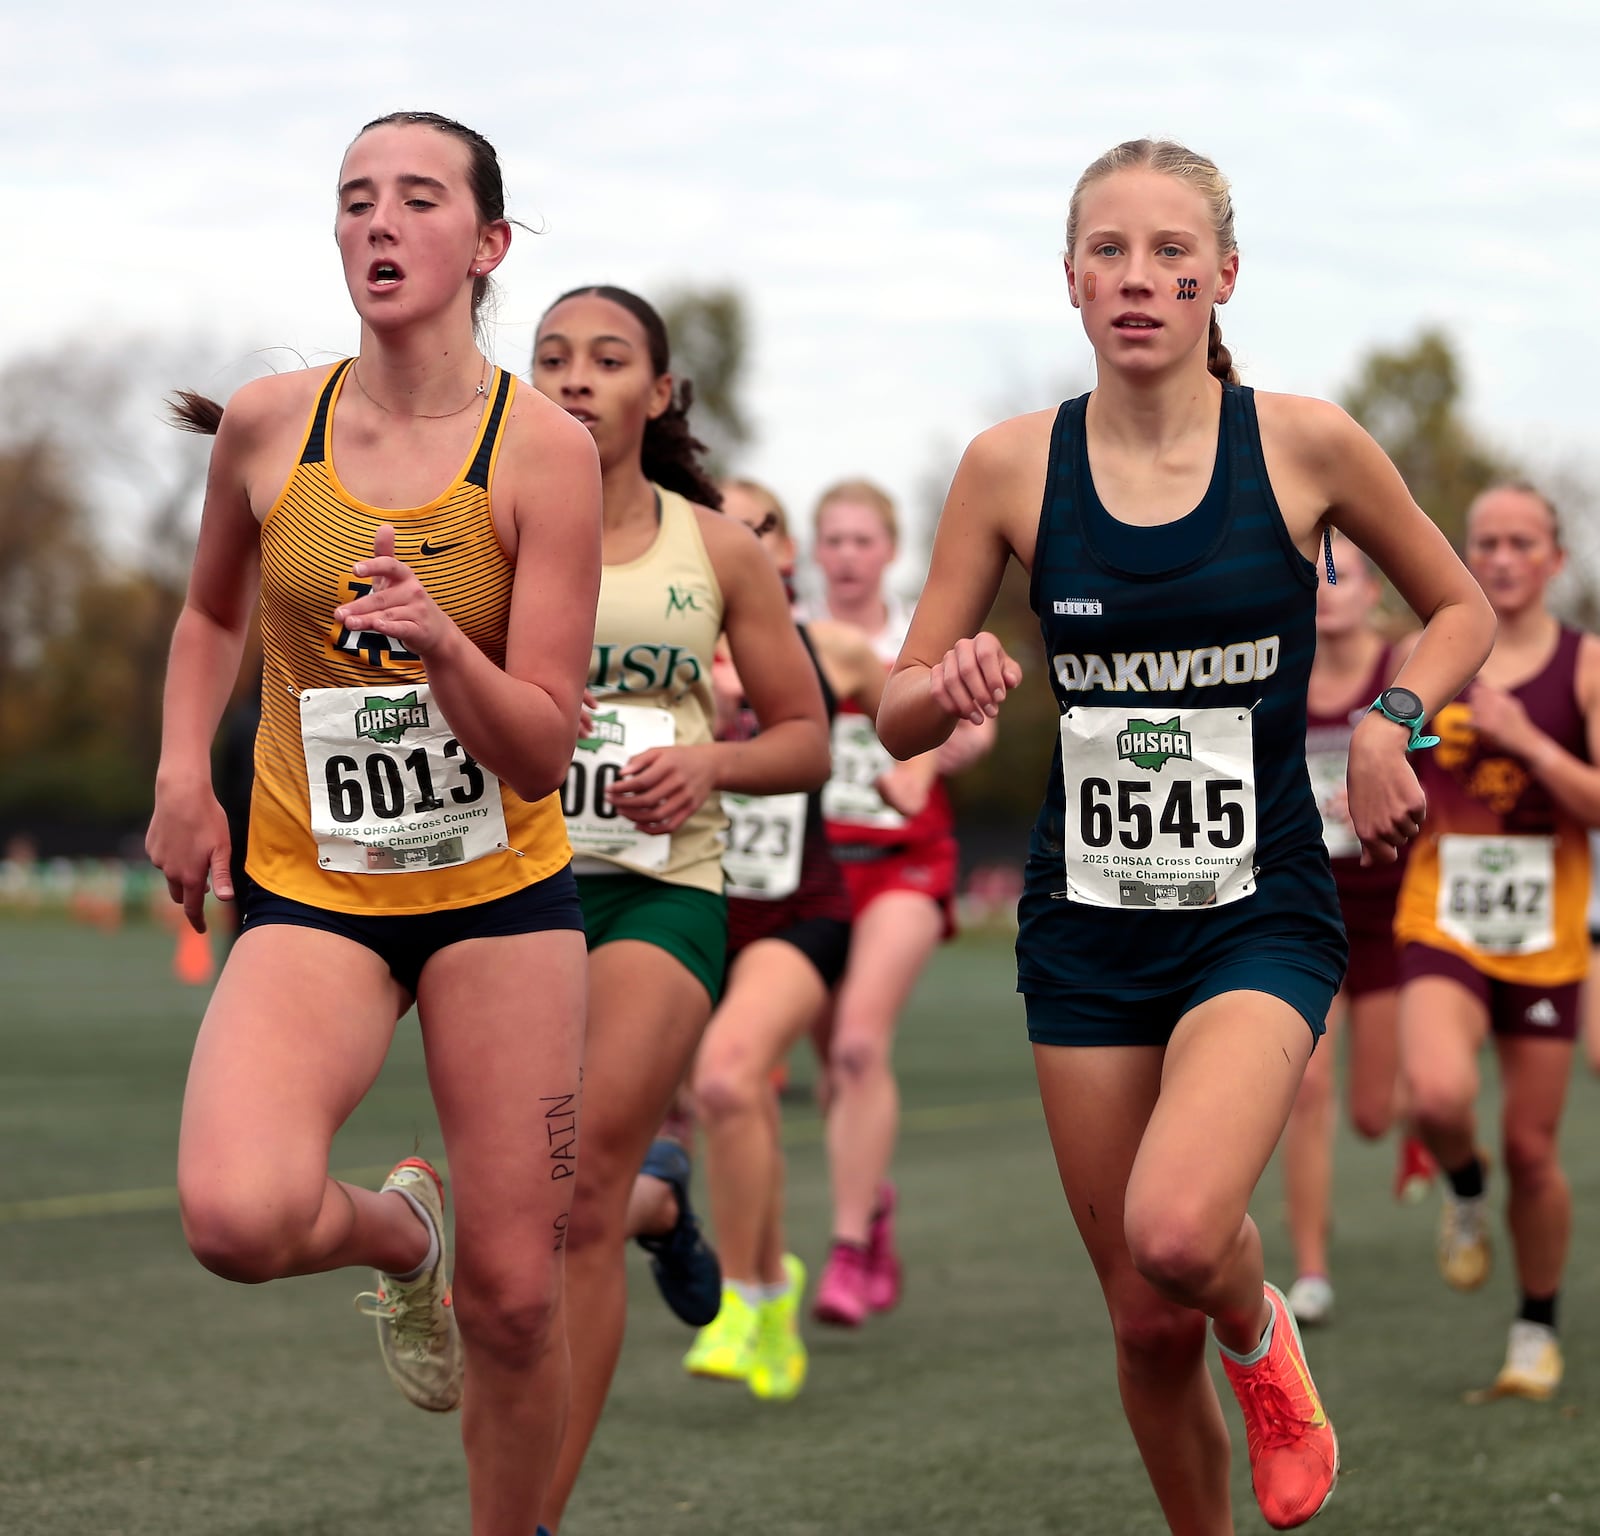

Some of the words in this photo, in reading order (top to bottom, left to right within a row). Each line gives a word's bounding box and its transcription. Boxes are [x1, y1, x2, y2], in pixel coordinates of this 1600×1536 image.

[1176, 278, 1198, 300] XC
[1053, 635, 1280, 692] OAKWOOD
[359, 706, 424, 733] OHSAA
[1121, 732, 1188, 756] OHSAA
[325, 739, 485, 823] 6013
[330, 827, 359, 837] 2025
[363, 825, 406, 836] OHSAA
[409, 819, 441, 831] Cross
[443, 807, 489, 824] Country
[1080, 777, 1244, 850] 6545
[353, 840, 385, 849] State
[388, 825, 470, 847] Championship
[1082, 854, 1109, 864] 2025
[1112, 856, 1153, 866] OHSAA
[1156, 857, 1191, 866] Cross
[1194, 856, 1243, 867] Country
[1103, 869, 1132, 879] State
[1136, 869, 1221, 881] Championship
[539, 1093, 576, 1181] PAIN
